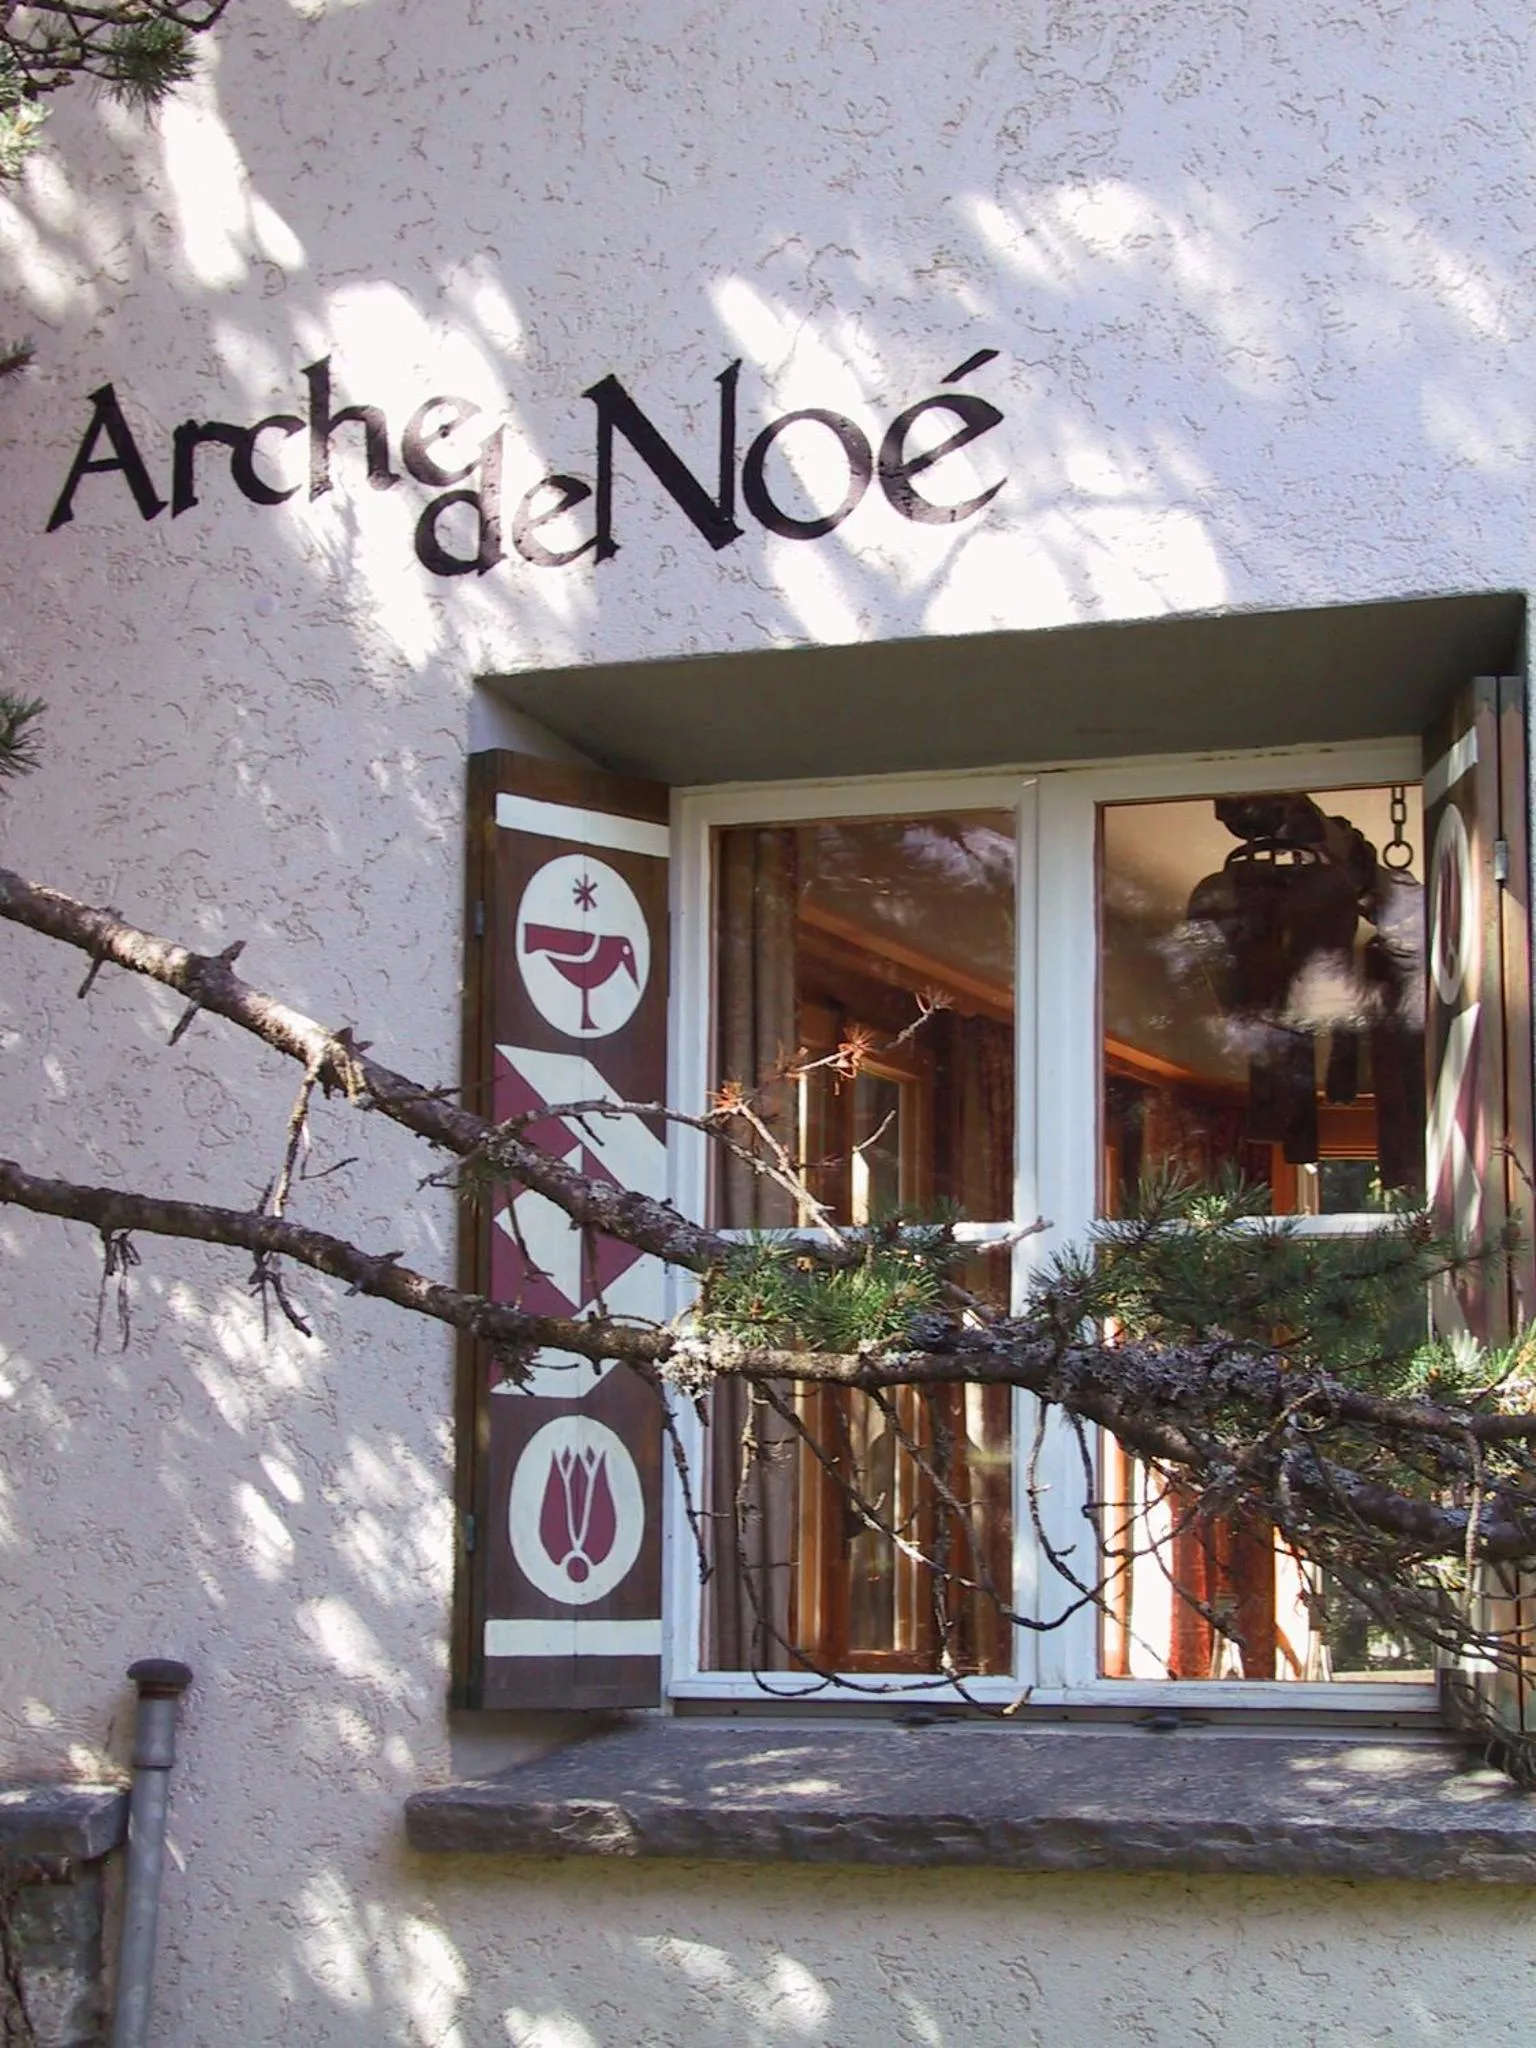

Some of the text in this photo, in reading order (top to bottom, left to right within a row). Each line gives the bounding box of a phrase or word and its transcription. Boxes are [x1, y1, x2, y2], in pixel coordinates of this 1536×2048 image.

[44, 348, 1009, 577] Arche de Noé
